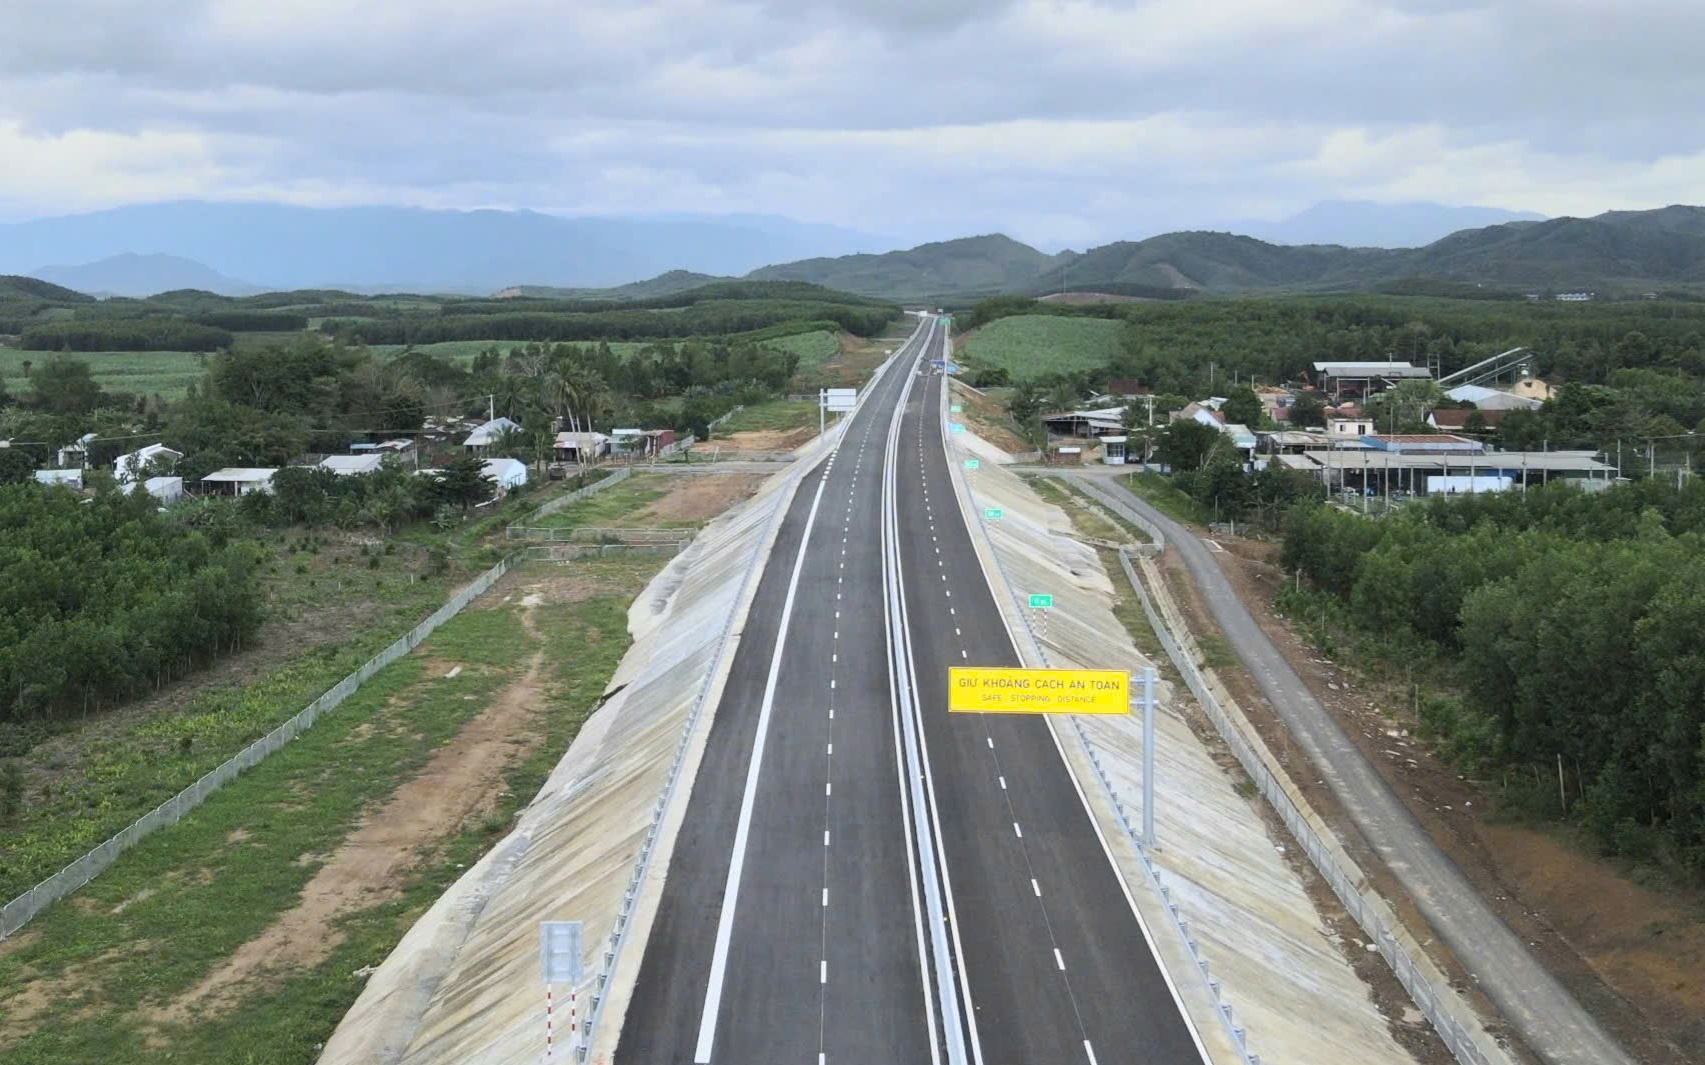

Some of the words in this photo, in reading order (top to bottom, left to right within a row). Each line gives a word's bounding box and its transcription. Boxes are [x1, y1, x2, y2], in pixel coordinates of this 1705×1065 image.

[1069, 680, 1085, 690] AN
[981, 693, 1002, 702] SAFE
[1010, 694, 1051, 703] STOPPING
[1057, 695, 1097, 704] DISTANCE
